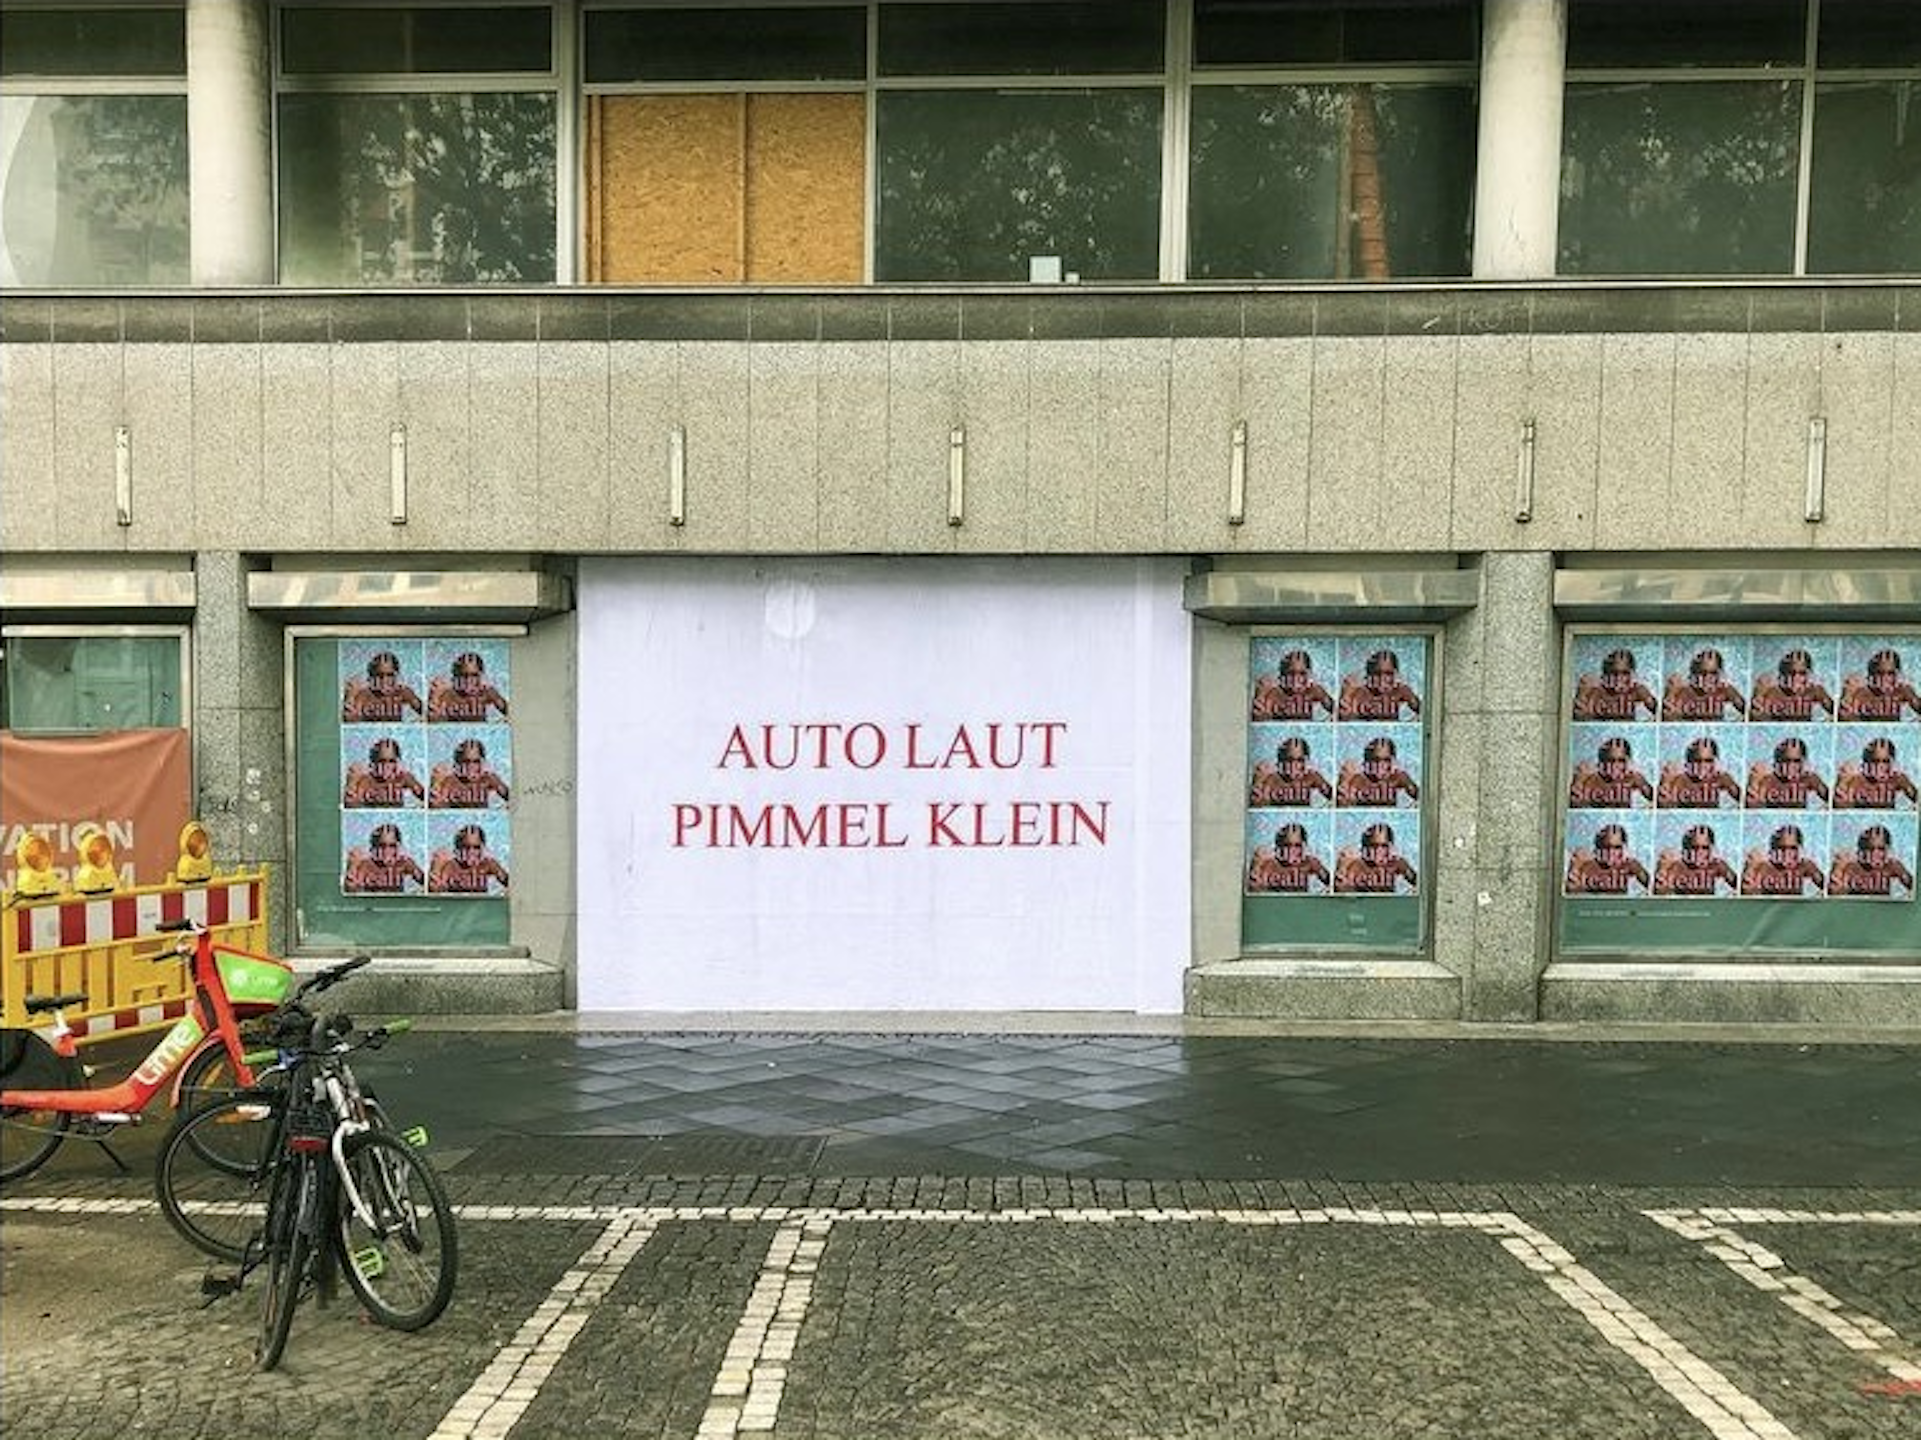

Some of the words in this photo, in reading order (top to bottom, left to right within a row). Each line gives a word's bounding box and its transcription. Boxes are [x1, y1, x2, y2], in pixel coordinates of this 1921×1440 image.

[716, 721, 888, 770] AUTO
[903, 722, 1067, 769] LAUT
[672, 803, 908, 848] PIMMEL
[928, 801, 1112, 847] KLEIN
